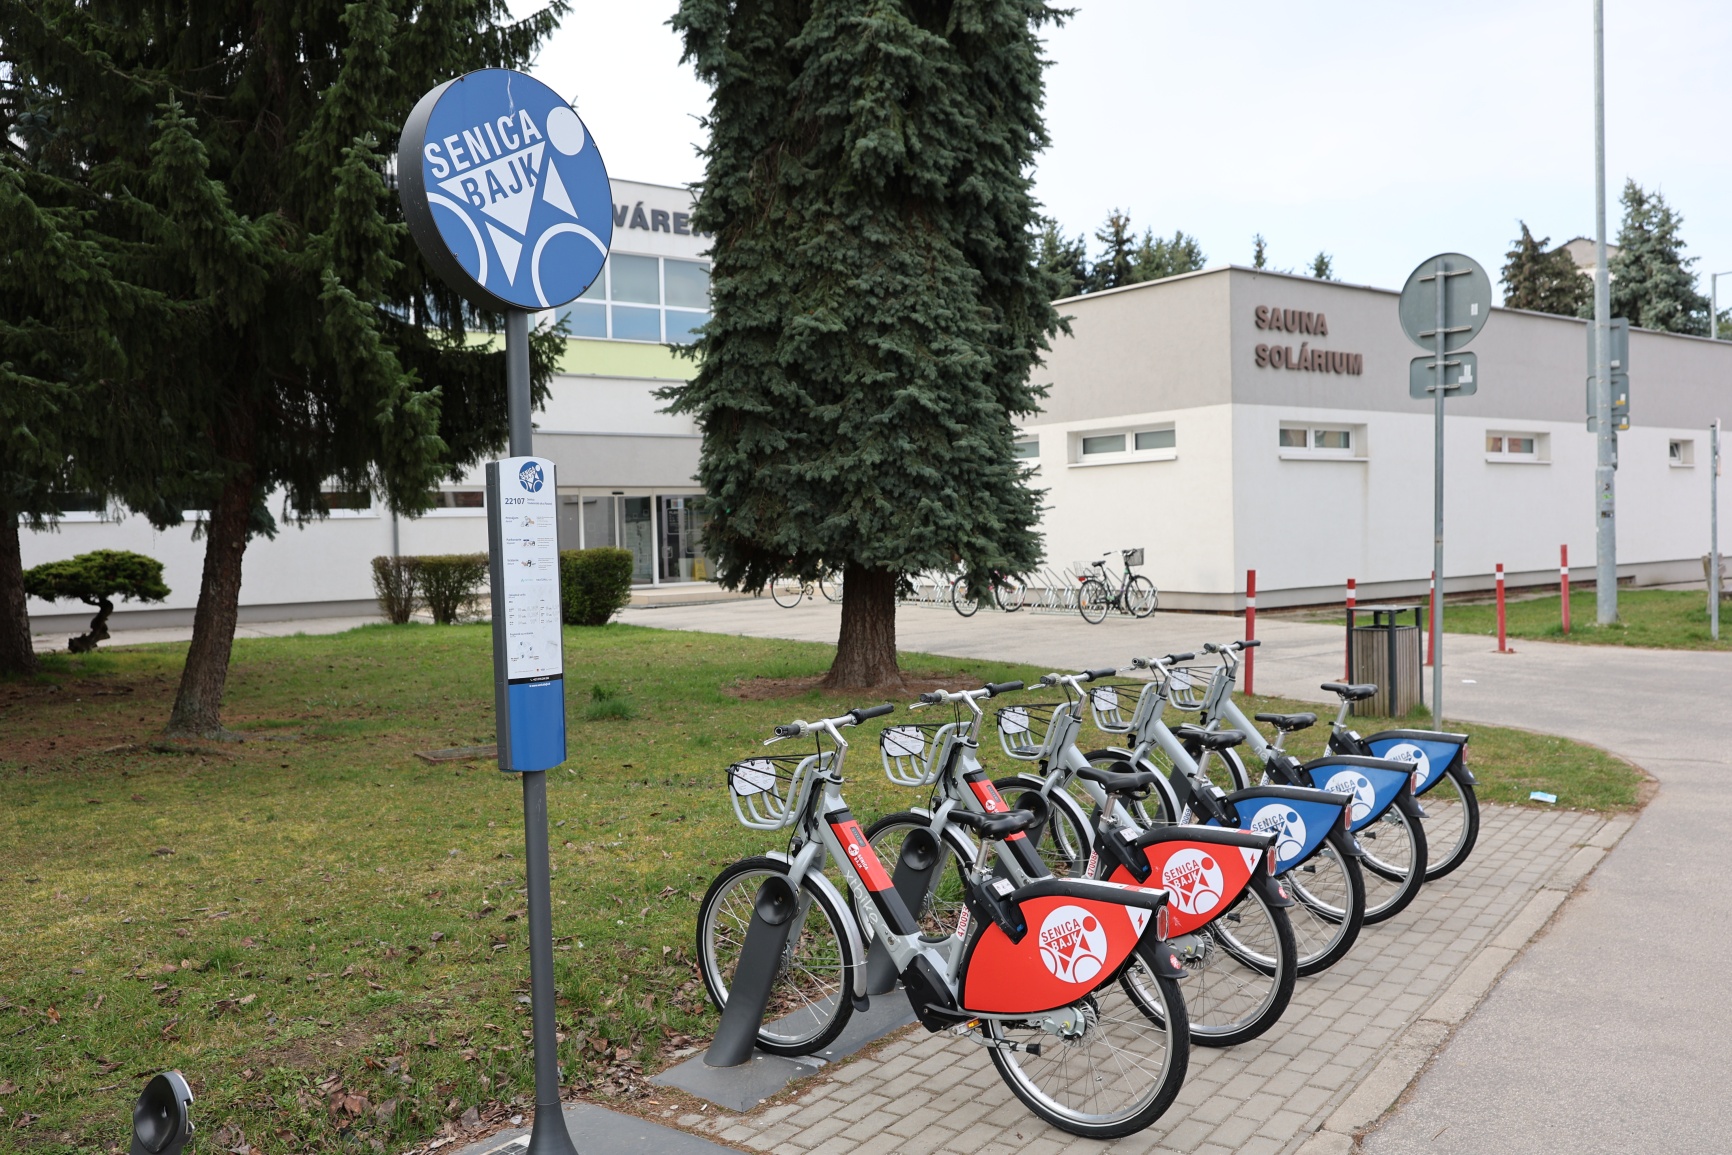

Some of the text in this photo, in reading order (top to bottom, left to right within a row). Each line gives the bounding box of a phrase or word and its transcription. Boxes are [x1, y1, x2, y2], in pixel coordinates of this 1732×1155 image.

[424, 109, 543, 178] SENICA
[460, 152, 540, 209] BAJK
[613, 201, 712, 238] VÁRE
[1255, 305, 1328, 336] SAUNA
[1255, 342, 1363, 375] SOLÁRIUM
[505, 497, 525, 505] 22107
[1389, 751, 1412, 761] NICA
[1252, 813, 1285, 832] SENICA
[1164, 859, 1200, 881] SENICA
[1173, 871, 1198, 888] BAJK
[844, 869, 878, 926] xtbike
[956, 906, 970, 937] 470093
[1041, 918, 1081, 942] SENICA
[1051, 932, 1078, 951] BAJK
